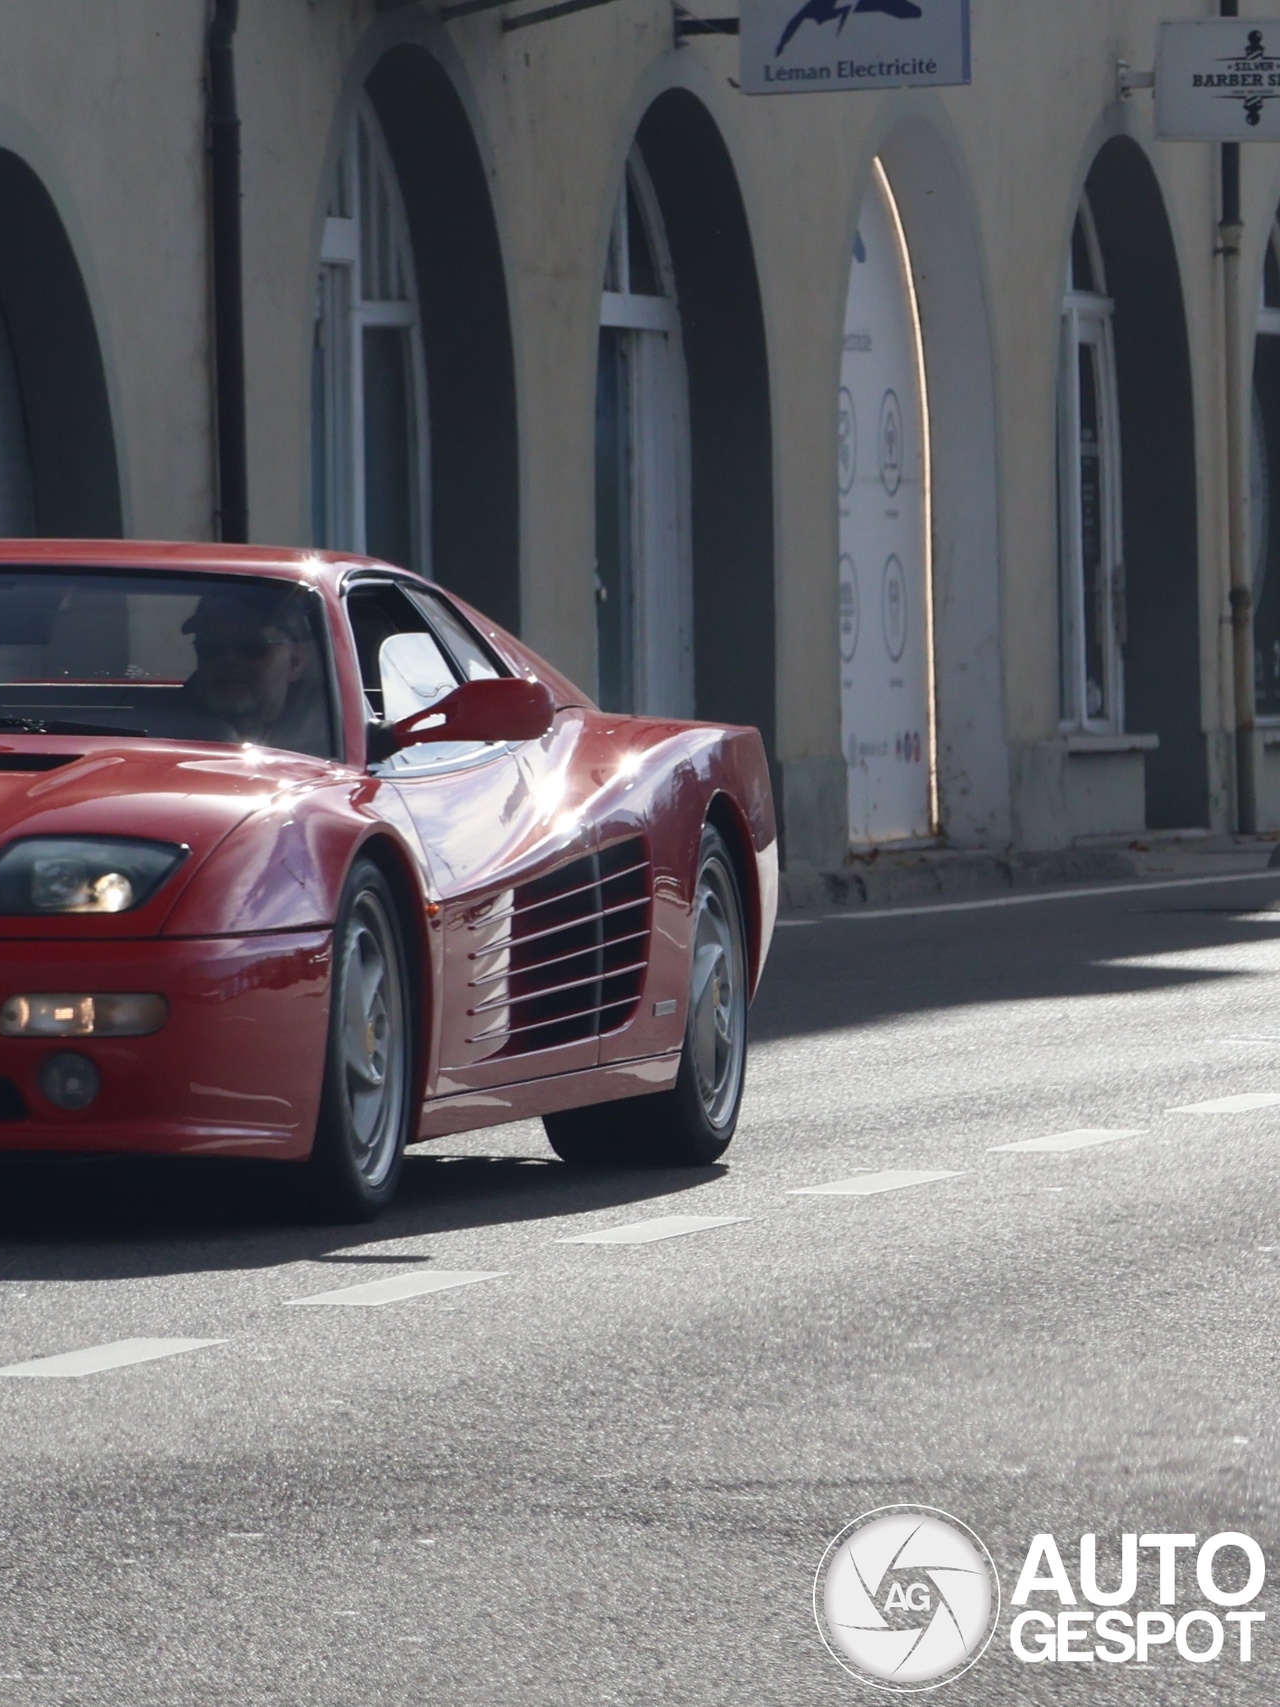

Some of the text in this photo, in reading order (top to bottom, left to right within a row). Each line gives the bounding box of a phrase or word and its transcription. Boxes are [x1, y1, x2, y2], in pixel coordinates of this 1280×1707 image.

[764, 58, 937, 82] Léman Electricité
[1234, 61, 1274, 71] SILVER
[1192, 73, 1280, 87] BARBER S
